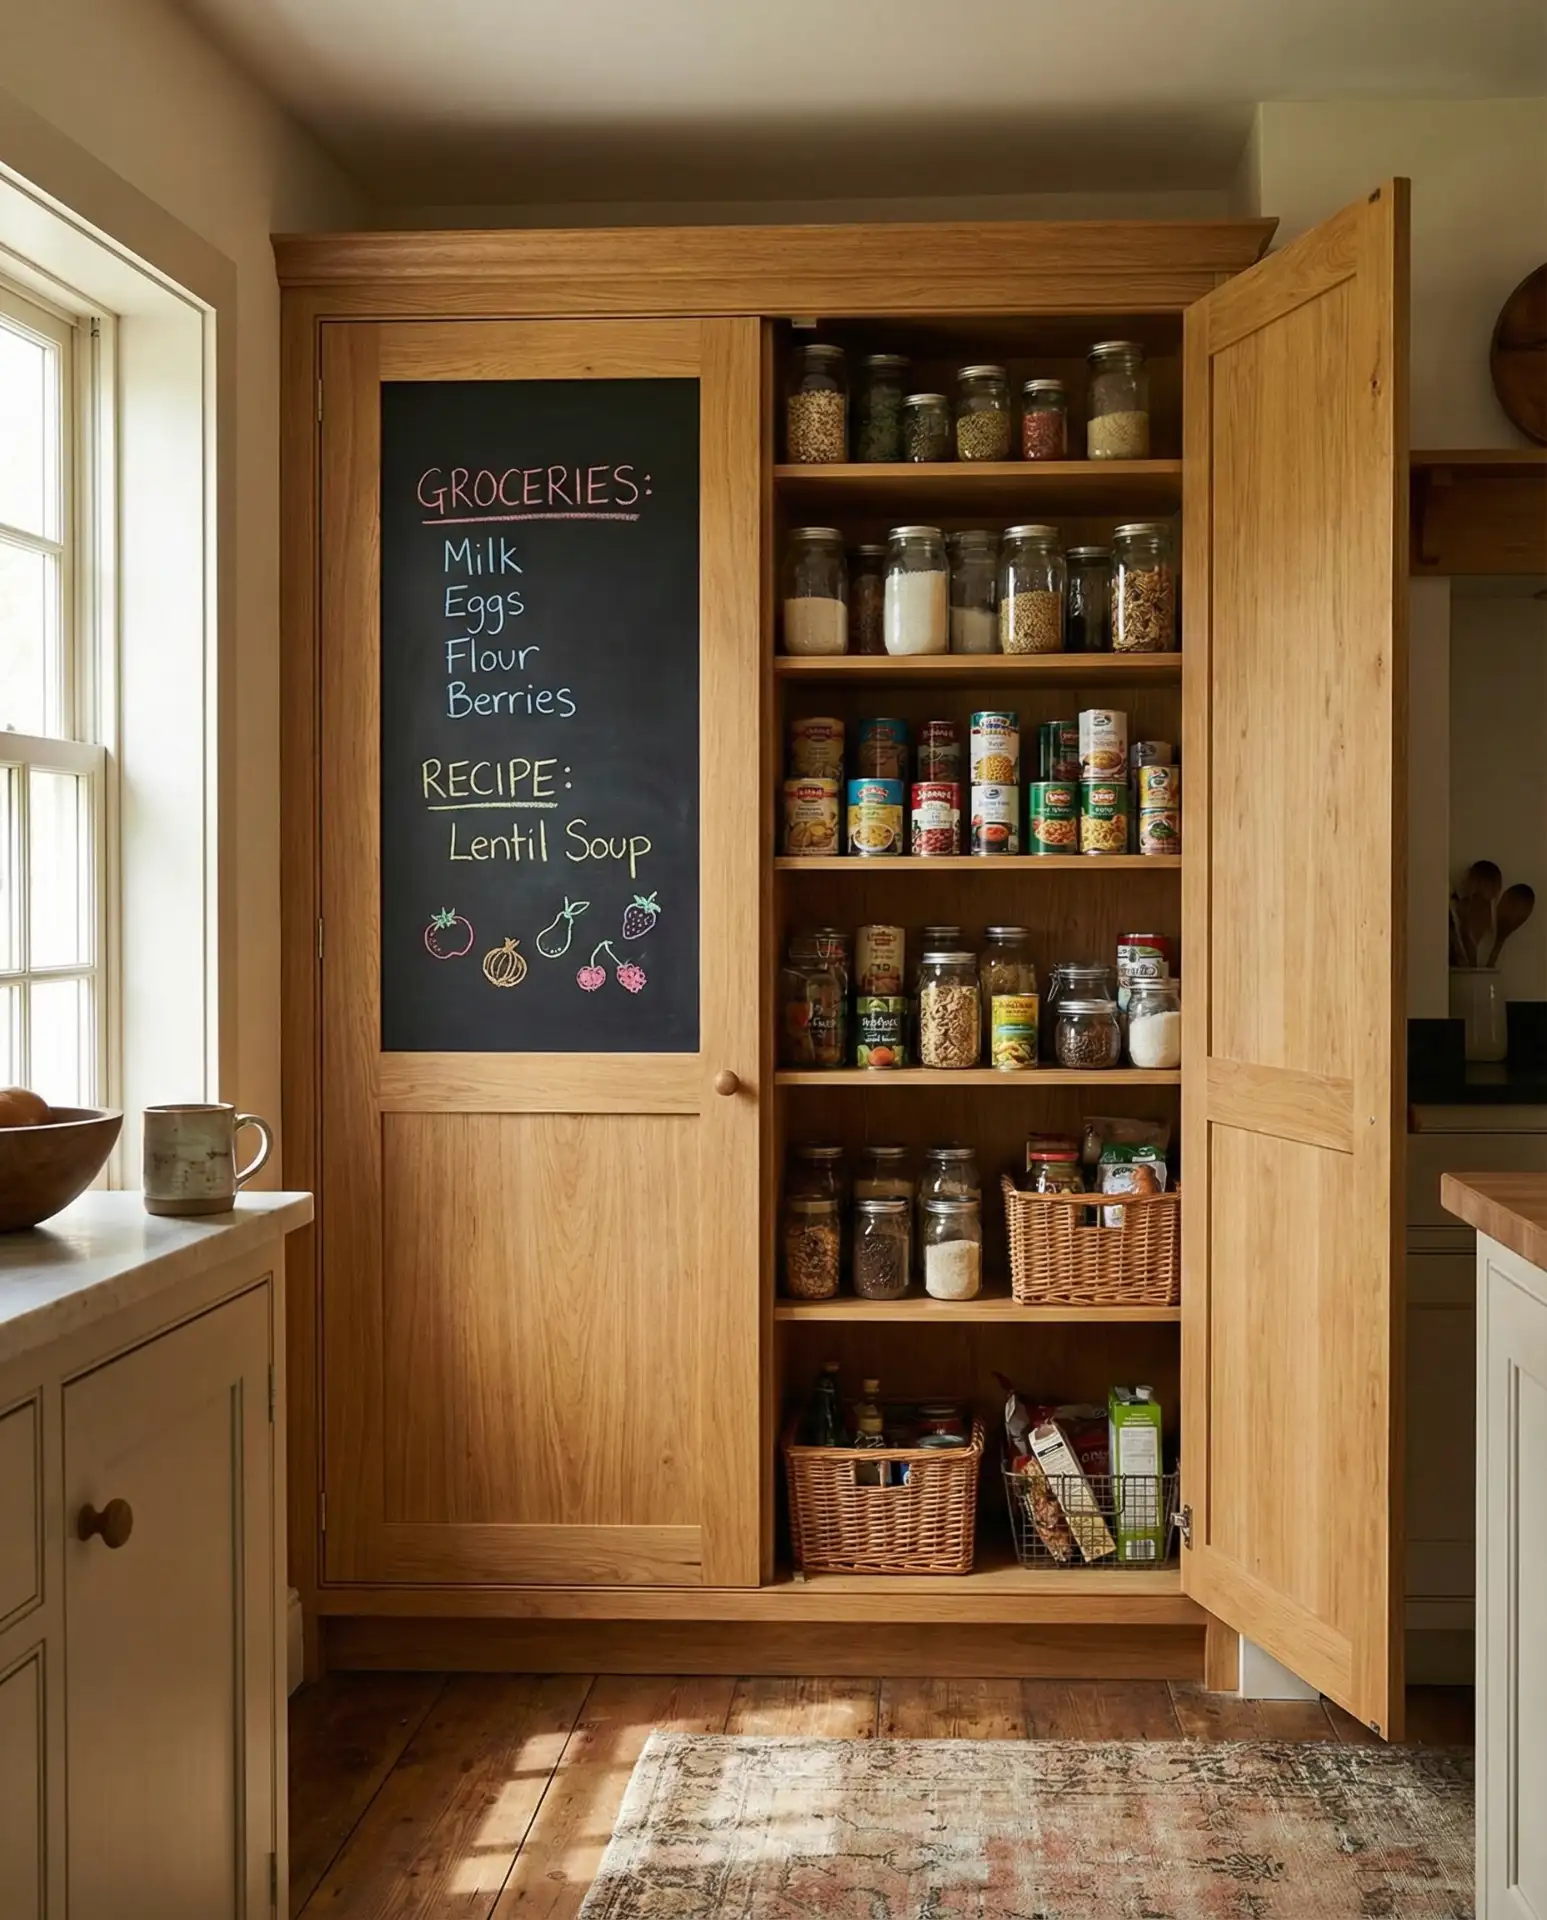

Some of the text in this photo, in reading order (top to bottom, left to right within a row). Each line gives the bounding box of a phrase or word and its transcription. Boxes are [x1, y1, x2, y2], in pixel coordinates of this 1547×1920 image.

[418, 465, 652, 514] GROCERIES:
[445, 537, 522, 575] Milk
[445, 585, 524, 634] Eggs
[446, 637, 540, 674] Flour
[447, 681, 576, 718] Berries
[422, 758, 571, 798] RECIPE:
[450, 819, 651, 879] Lentil Soup
